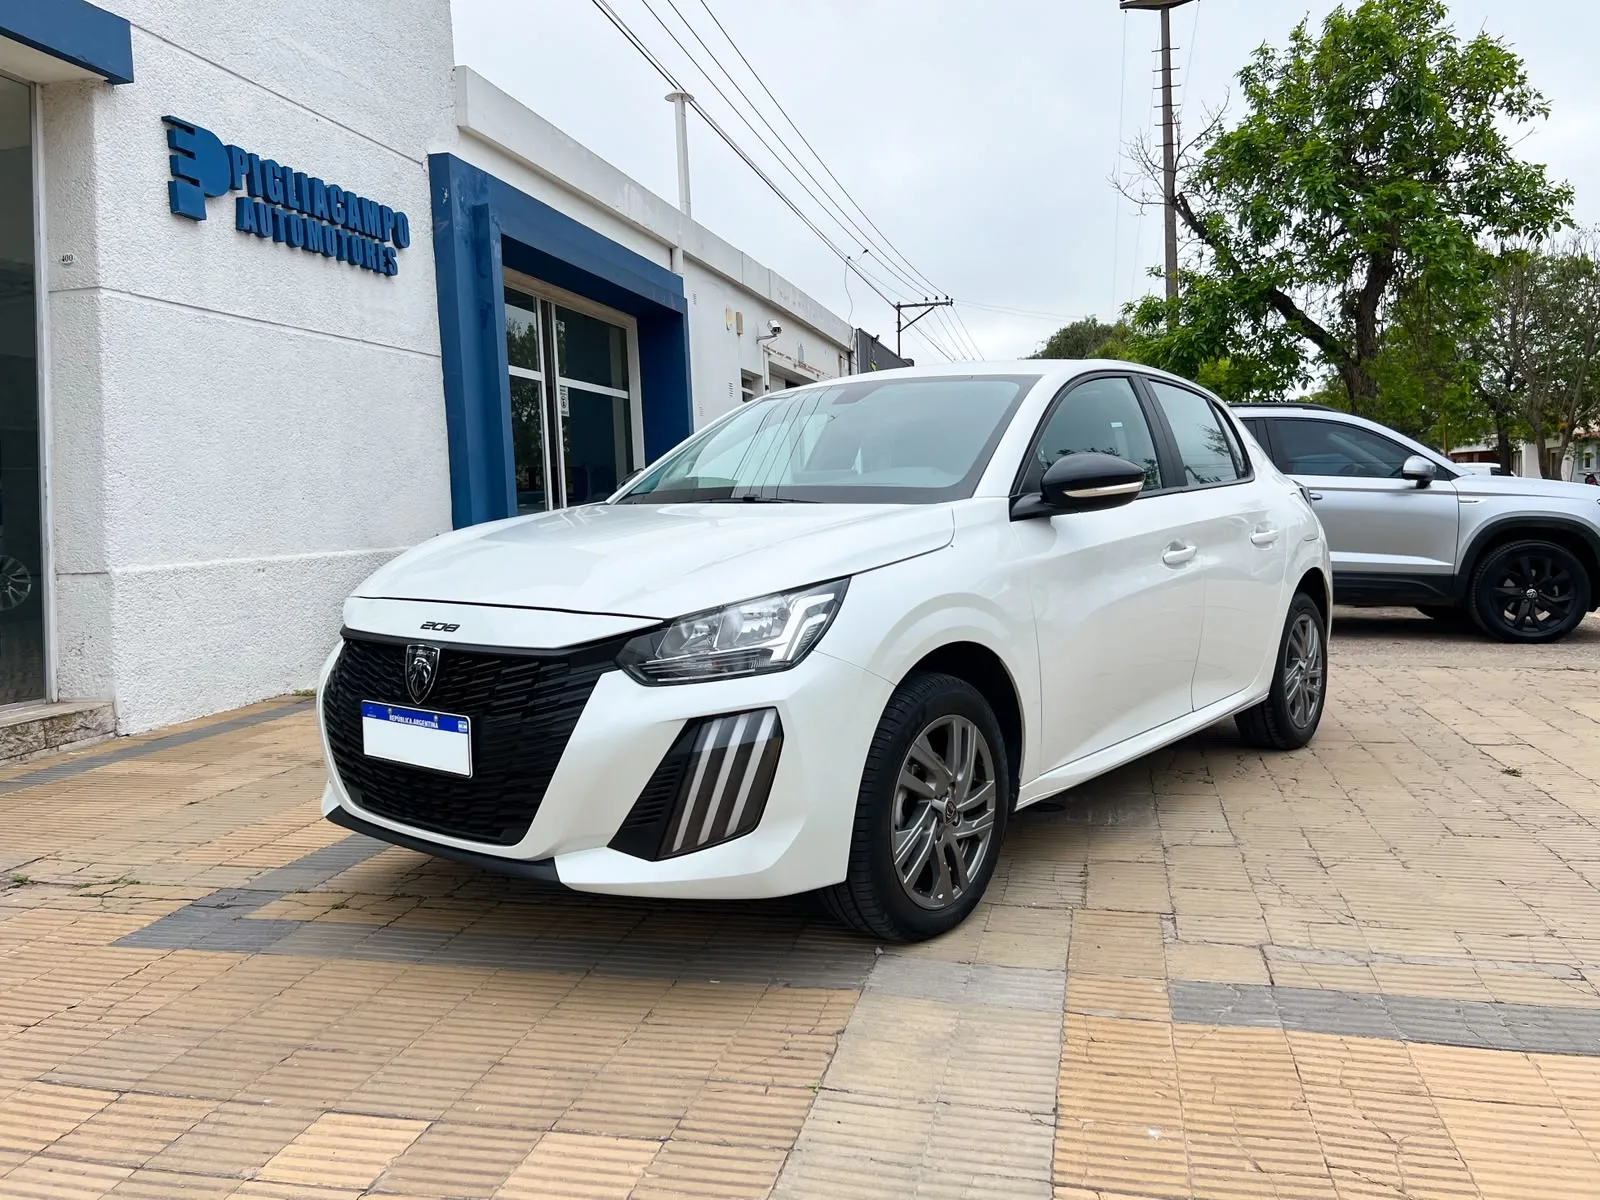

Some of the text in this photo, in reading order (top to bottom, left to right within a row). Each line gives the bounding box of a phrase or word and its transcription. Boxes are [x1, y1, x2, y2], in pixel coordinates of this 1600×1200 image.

[225, 144, 410, 249] PIGLIACAMPO
[236, 196, 398, 277] AUTOMOTORES
[420, 621, 460, 632] 208
[413, 718, 438, 729] ARGENTINA
